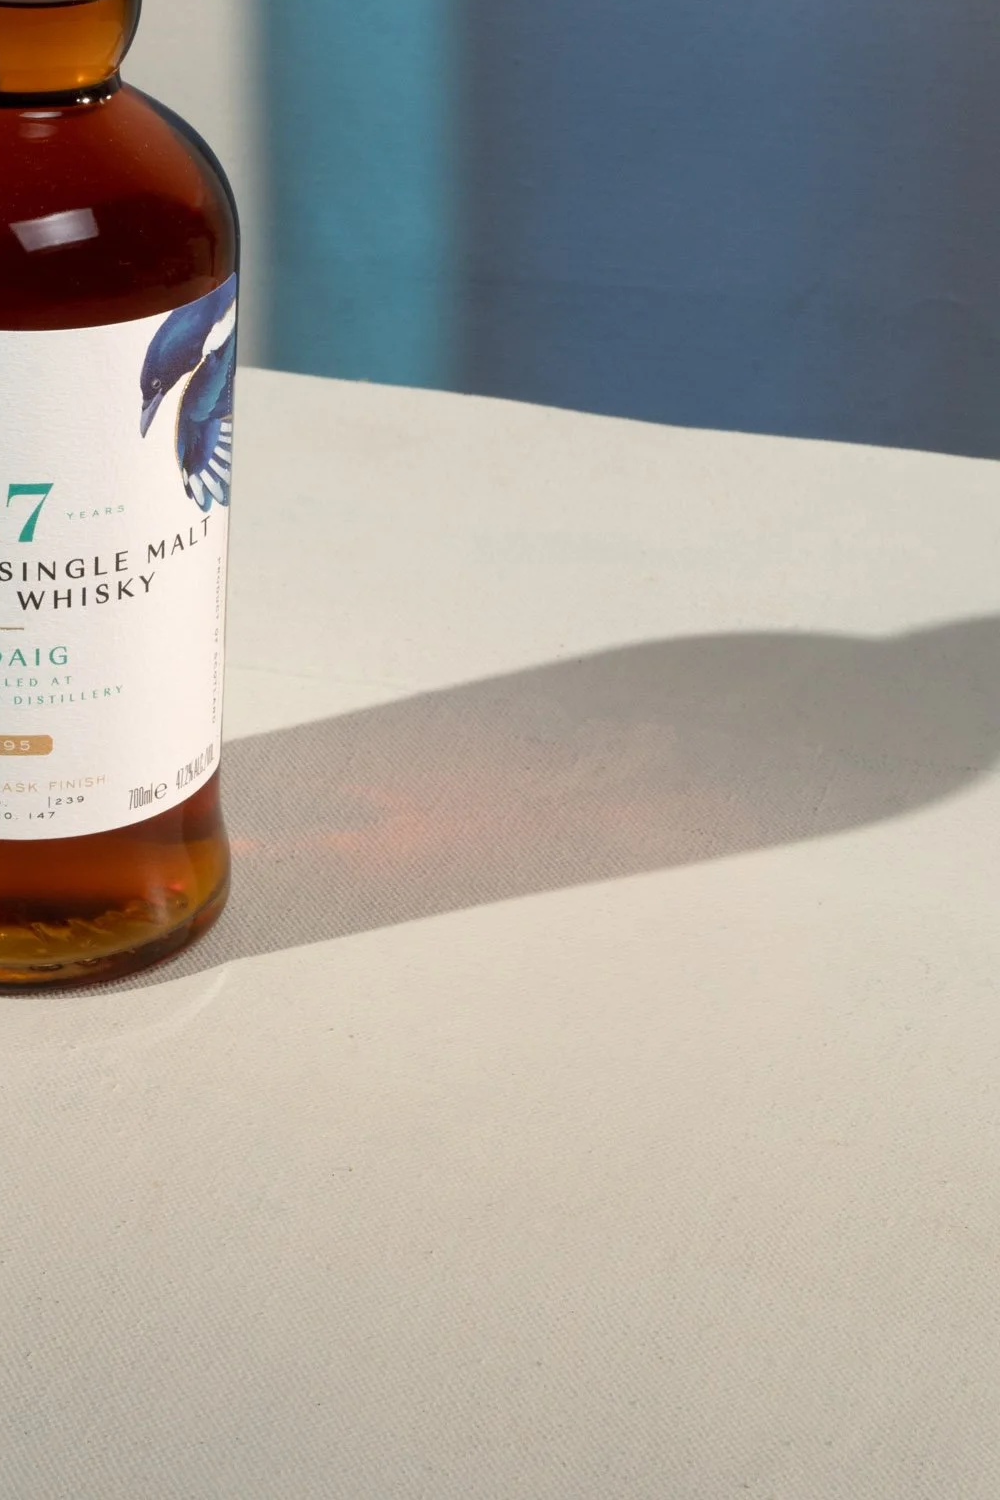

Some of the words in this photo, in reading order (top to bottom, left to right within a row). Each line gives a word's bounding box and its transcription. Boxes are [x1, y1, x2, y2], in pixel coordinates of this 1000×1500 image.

[66, 504, 125, 521] YEARS
[147, 515, 211, 564] MALT
[16, 571, 156, 611] WHISKY
[51, 675, 73, 686] AT
[13, 684, 124, 706] DISTILLERY
[49, 774, 106, 792] FINISH
[128, 782, 153, 811] 700ml
